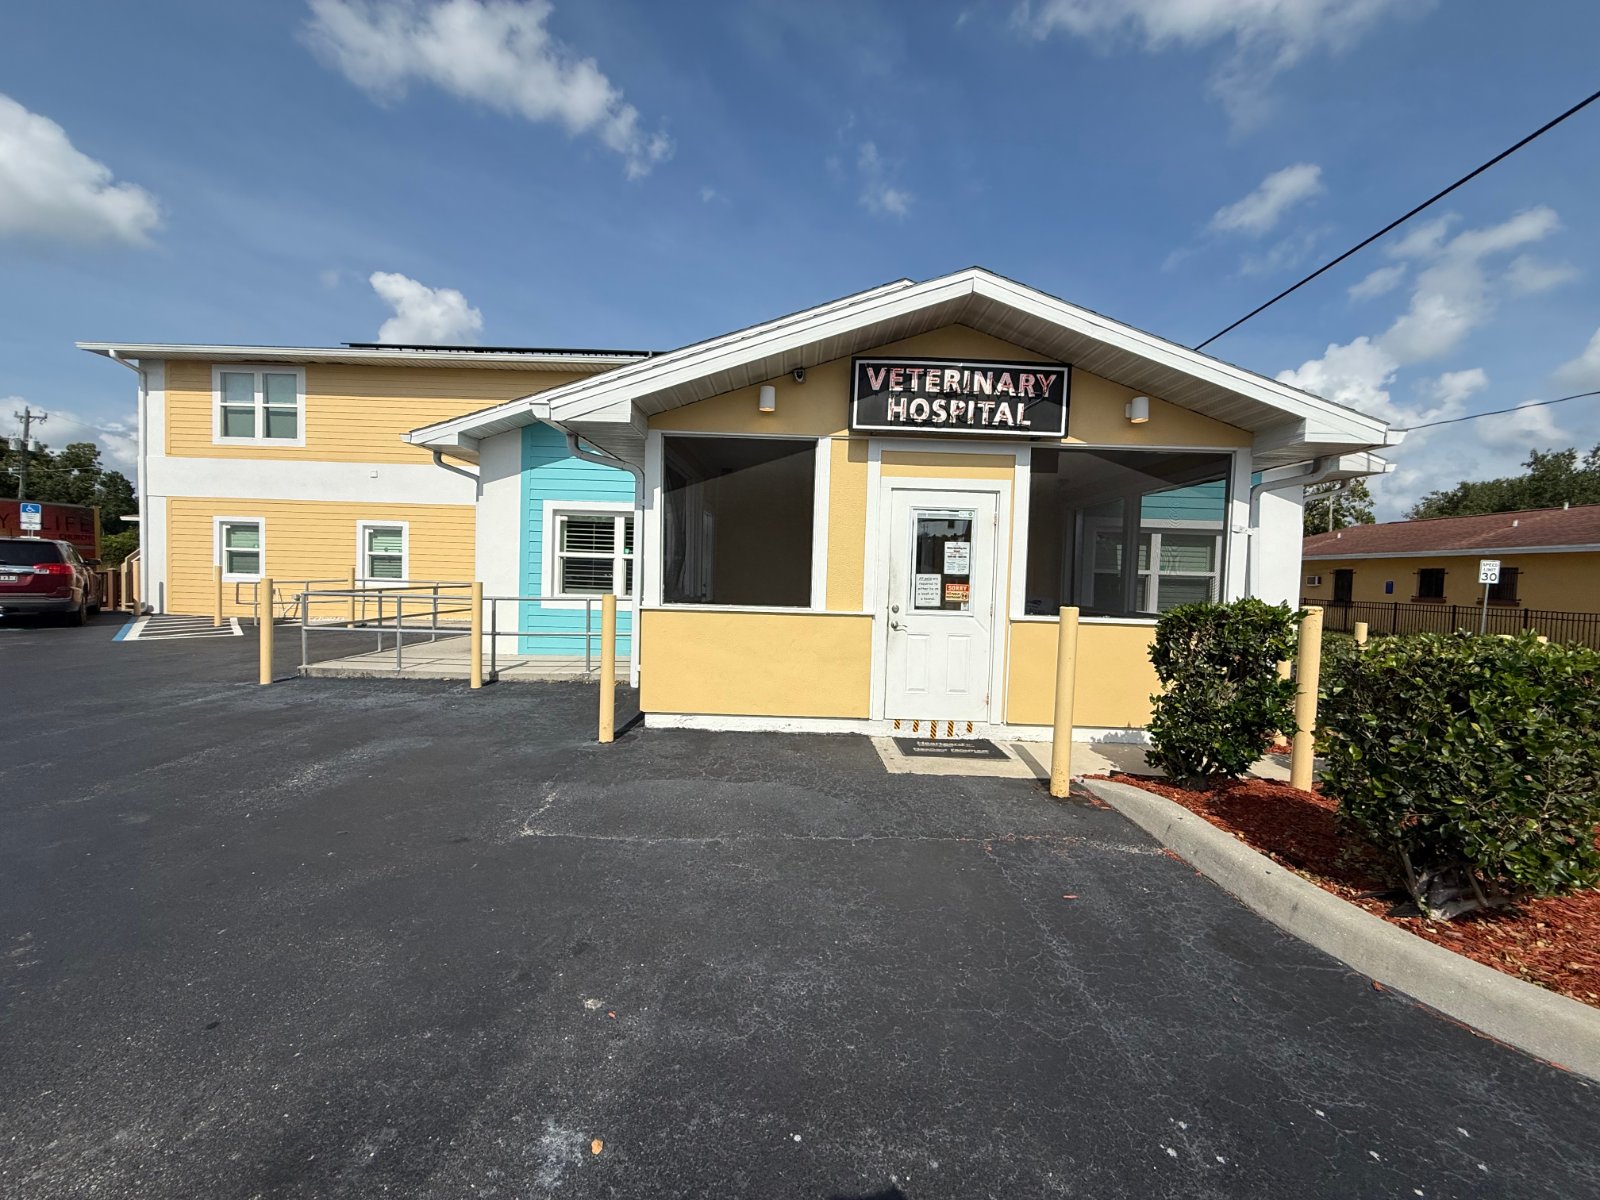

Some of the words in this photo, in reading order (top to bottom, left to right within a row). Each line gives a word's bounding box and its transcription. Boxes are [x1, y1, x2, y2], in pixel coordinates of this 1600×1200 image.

[866, 366, 1057, 398] VETERINARY
[887, 396, 1031, 426] HOSPITAL
[1481, 572, 1497, 582] 30
